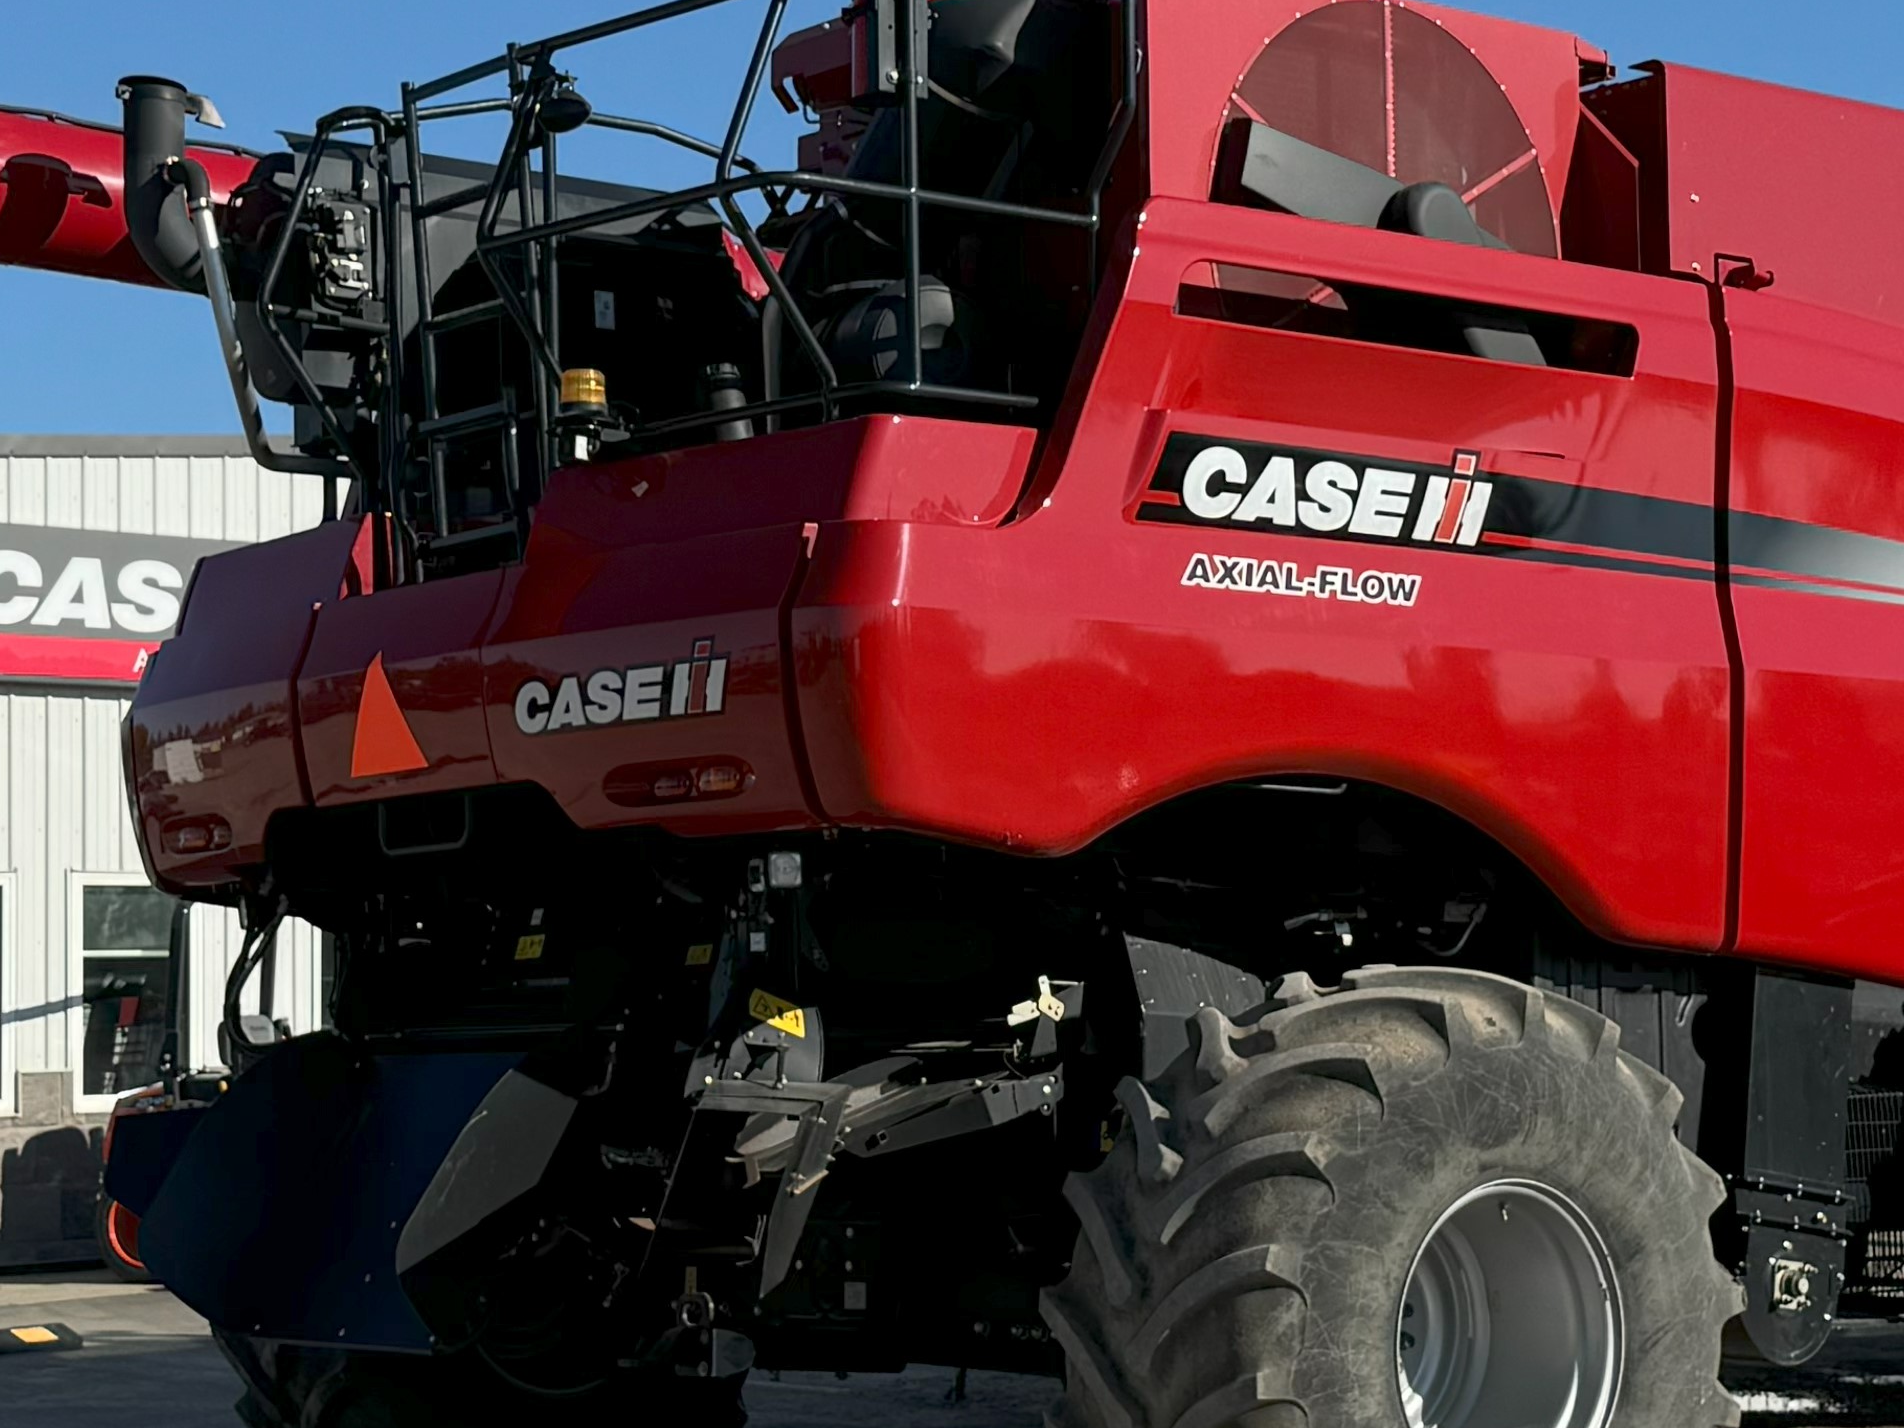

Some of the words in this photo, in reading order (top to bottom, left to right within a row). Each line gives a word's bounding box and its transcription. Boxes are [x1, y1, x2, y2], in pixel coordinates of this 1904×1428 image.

[1183, 446, 1416, 538] CASE
[1183, 554, 1420, 605] AXIAL-FLOW
[515, 666, 664, 734] CASE
